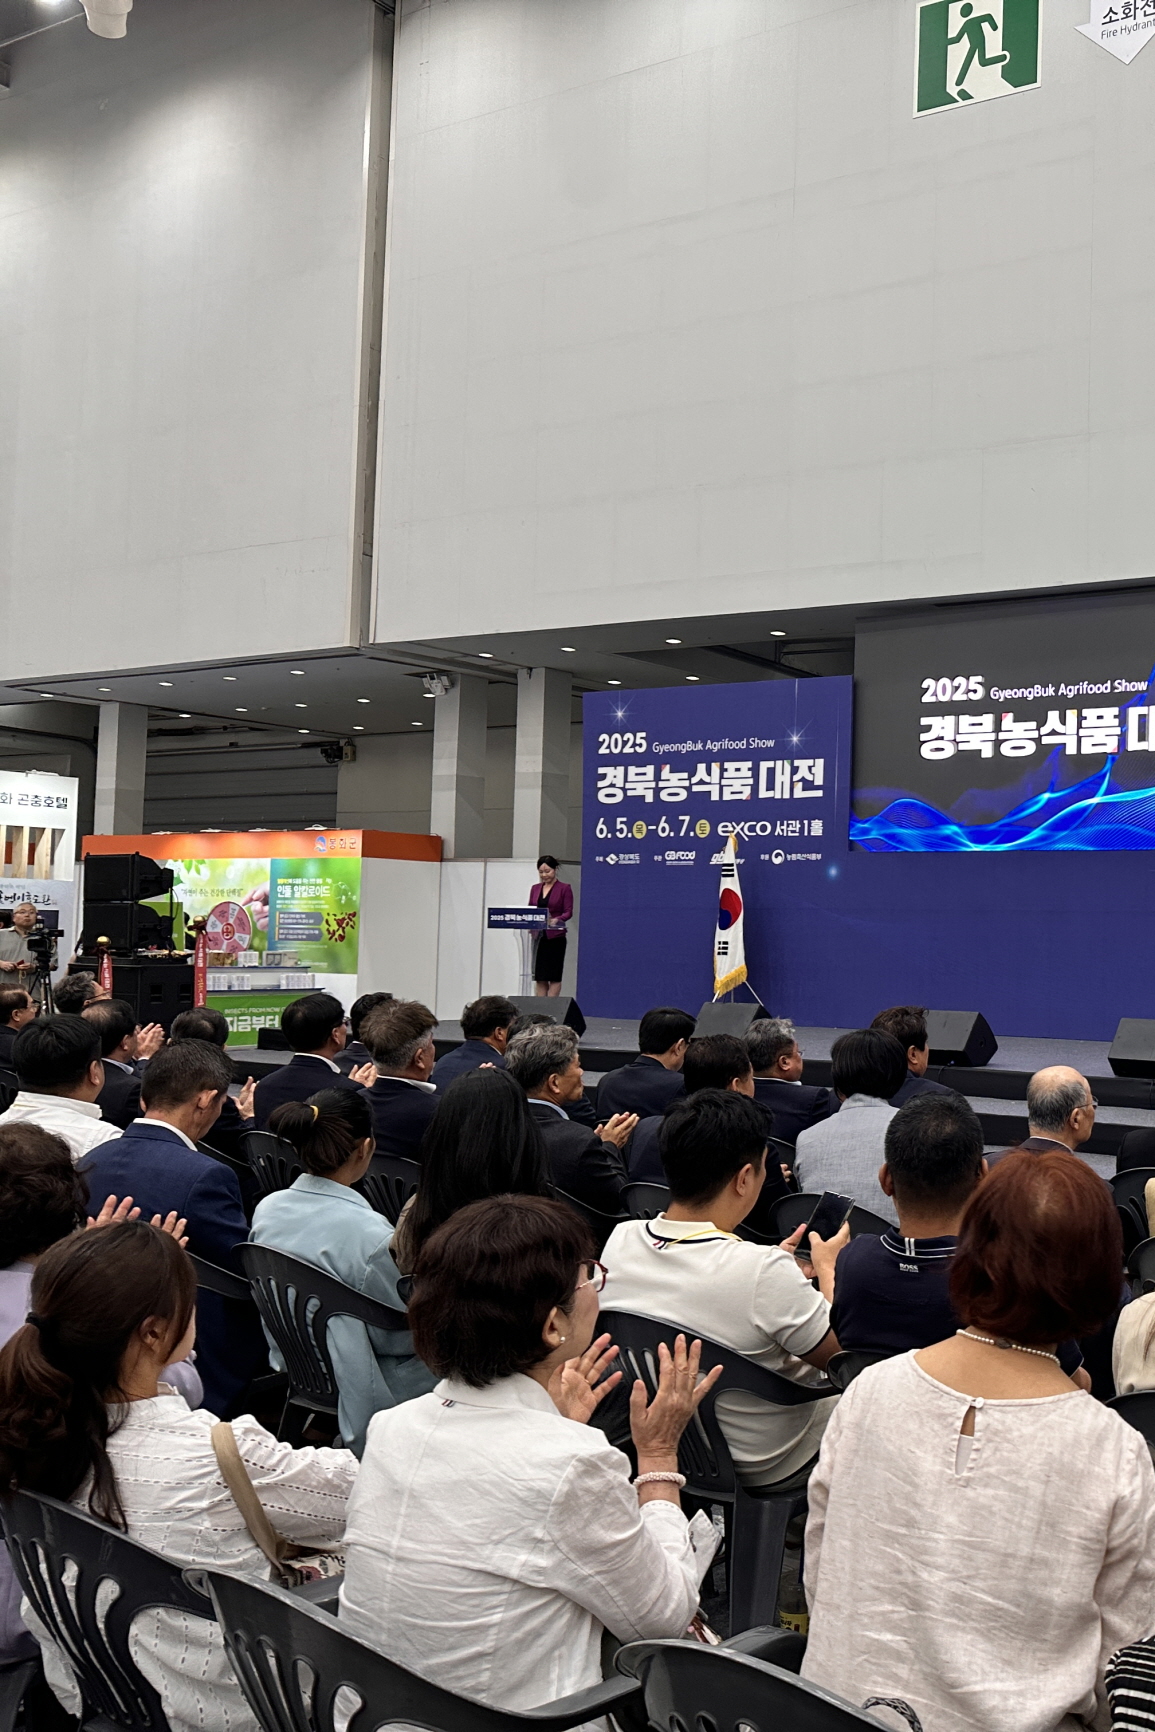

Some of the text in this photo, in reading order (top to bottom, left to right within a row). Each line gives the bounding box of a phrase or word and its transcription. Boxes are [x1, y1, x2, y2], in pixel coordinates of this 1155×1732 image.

[1101, 0, 1155, 25] 소화전
[1101, 18, 1155, 40] Fire Hydrant
[921, 675, 1148, 703] 2025 GyeongBuk Agrifood Show
[598, 732, 775, 755] 2025 GyeongBuk Agrifood Show
[758, 758, 825, 800] 대전
[17, 793, 68, 809] 곤충호텔
[774, 820, 801, 837] 서관
[803, 819, 824, 837] 1홀
[225, 1015, 279, 1032] 지금부터
